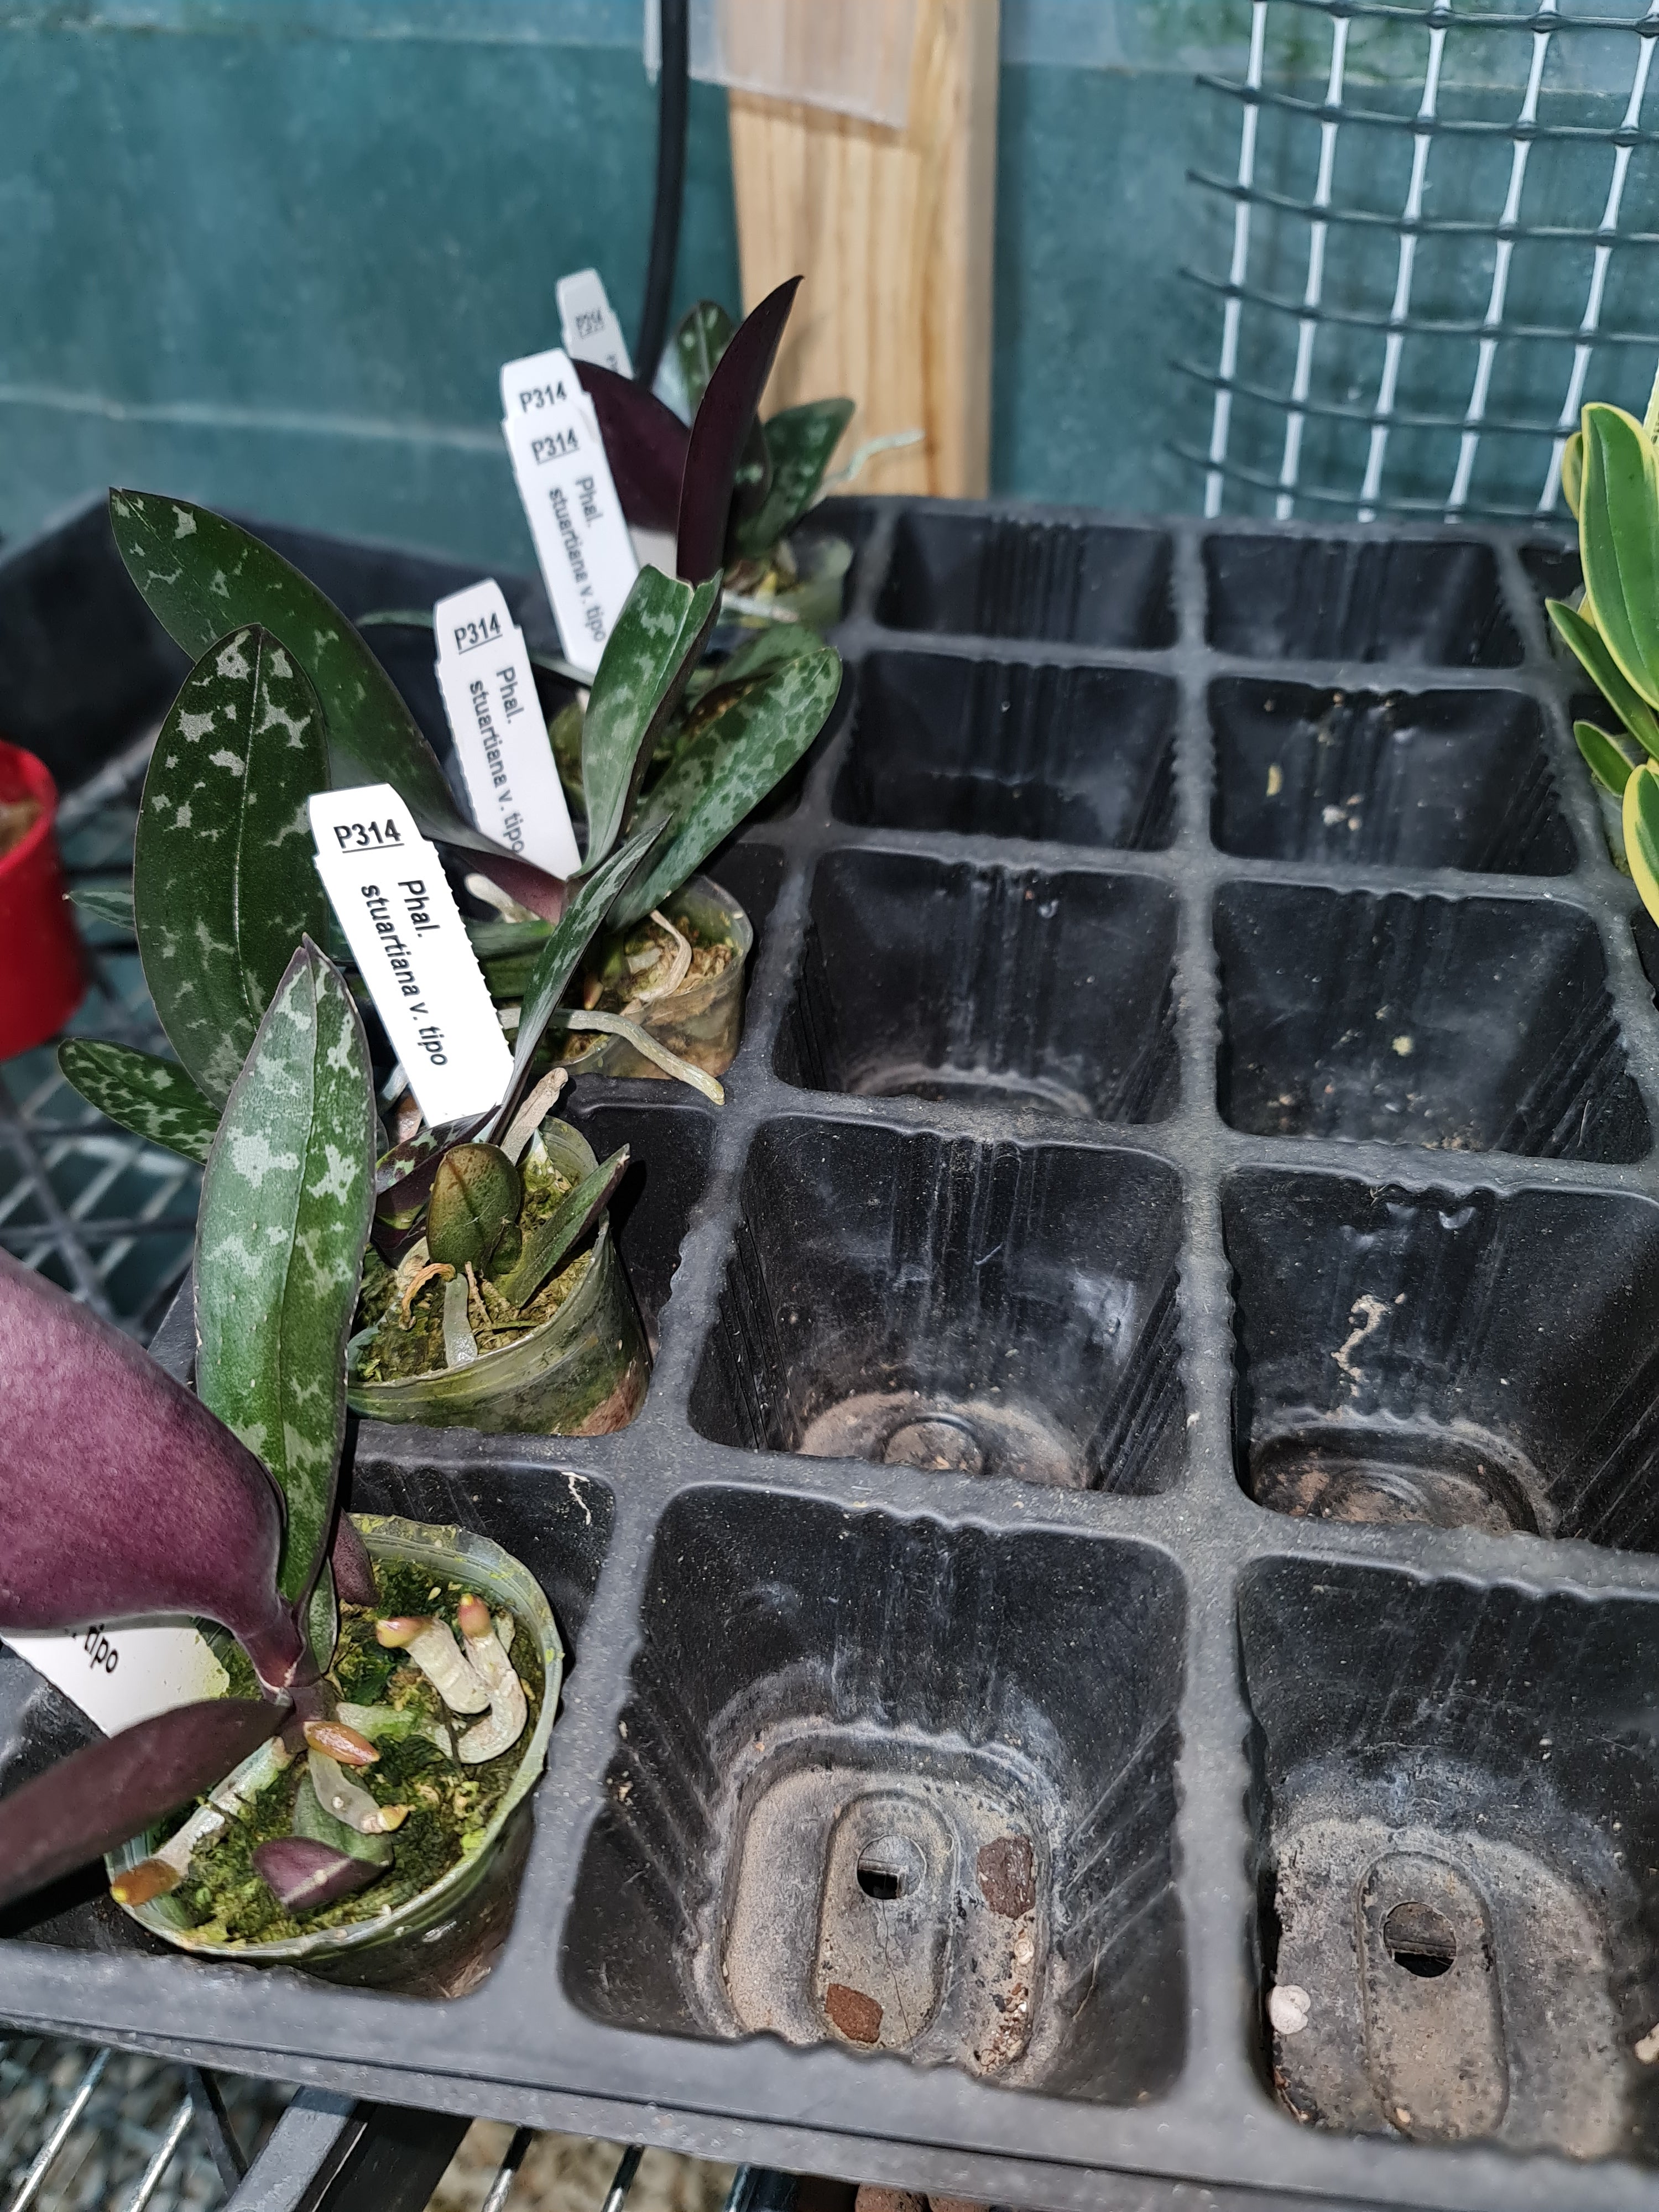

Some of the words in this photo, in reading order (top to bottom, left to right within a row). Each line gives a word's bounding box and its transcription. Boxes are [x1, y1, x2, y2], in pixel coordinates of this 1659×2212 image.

[520, 381, 567, 413] P314
[531, 429, 579, 462] P314
[576, 477, 603, 528] Phal.
[549, 488, 588, 583] stuartiana
[585, 606, 606, 643] tipo
[454, 612, 501, 651] P314
[497, 666, 524, 724] Phal.
[470, 680, 507, 788] stuartiana
[499, 789, 512, 811] v.
[333, 818, 401, 849] P314
[504, 812, 525, 853] tipo
[398, 880, 440, 937] Phal.
[361, 885, 420, 997] stuartiana
[409, 1002, 429, 1021] v.
[417, 1026, 448, 1066] tipo
[84, 1624, 118, 1673] tipo
